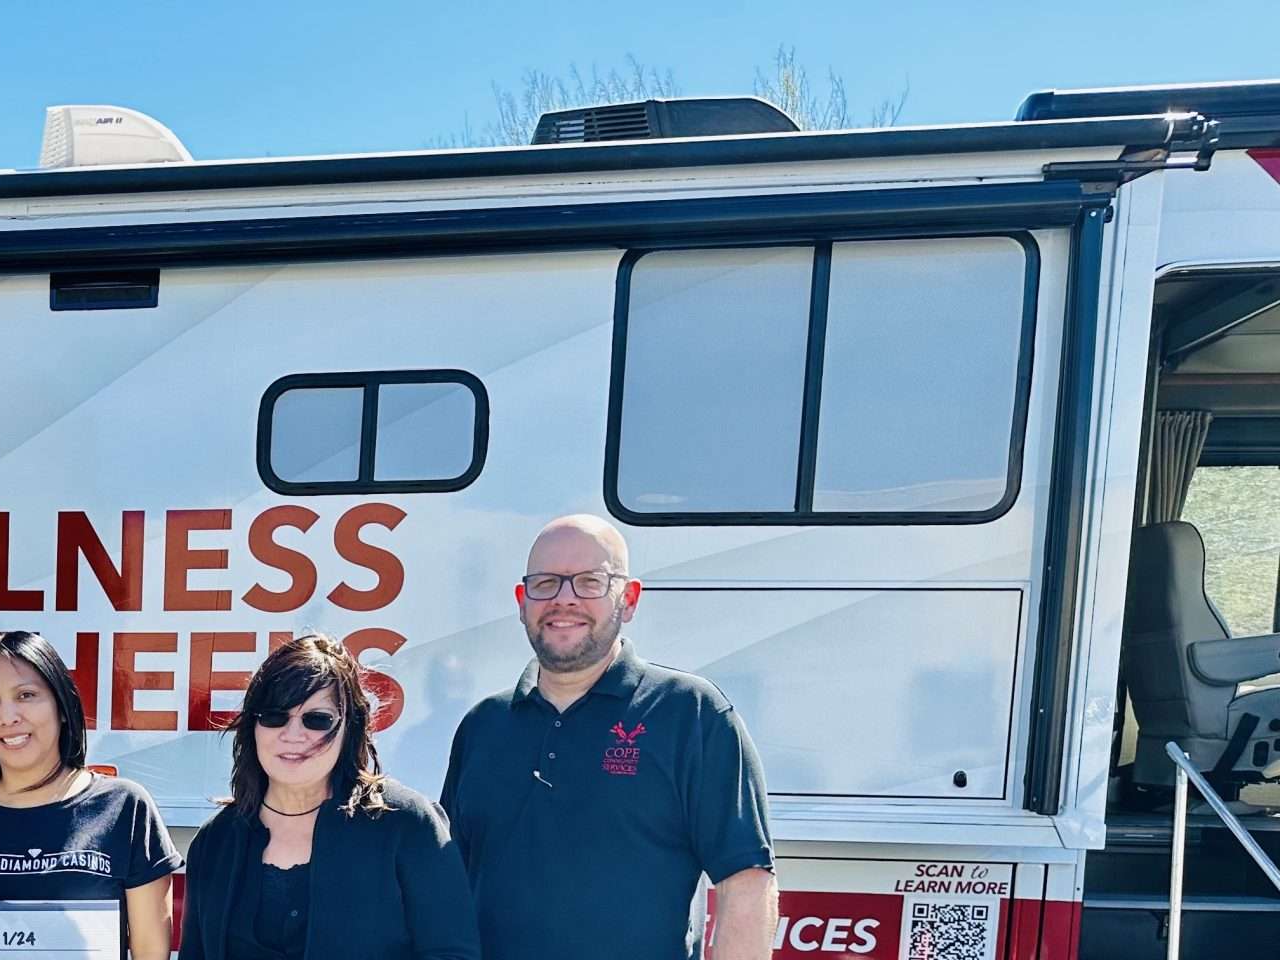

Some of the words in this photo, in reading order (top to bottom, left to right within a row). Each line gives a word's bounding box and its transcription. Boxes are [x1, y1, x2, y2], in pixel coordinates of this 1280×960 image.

[605, 747, 640, 758] COPE
[0, 857, 57, 871] DIAMOND
[62, 853, 111, 873] CASINOS
[915, 864, 963, 878] SCAN
[970, 864, 990, 879] to
[894, 879, 955, 894] LEARN
[958, 881, 1008, 895] MORE
[772, 916, 881, 954] ICES
